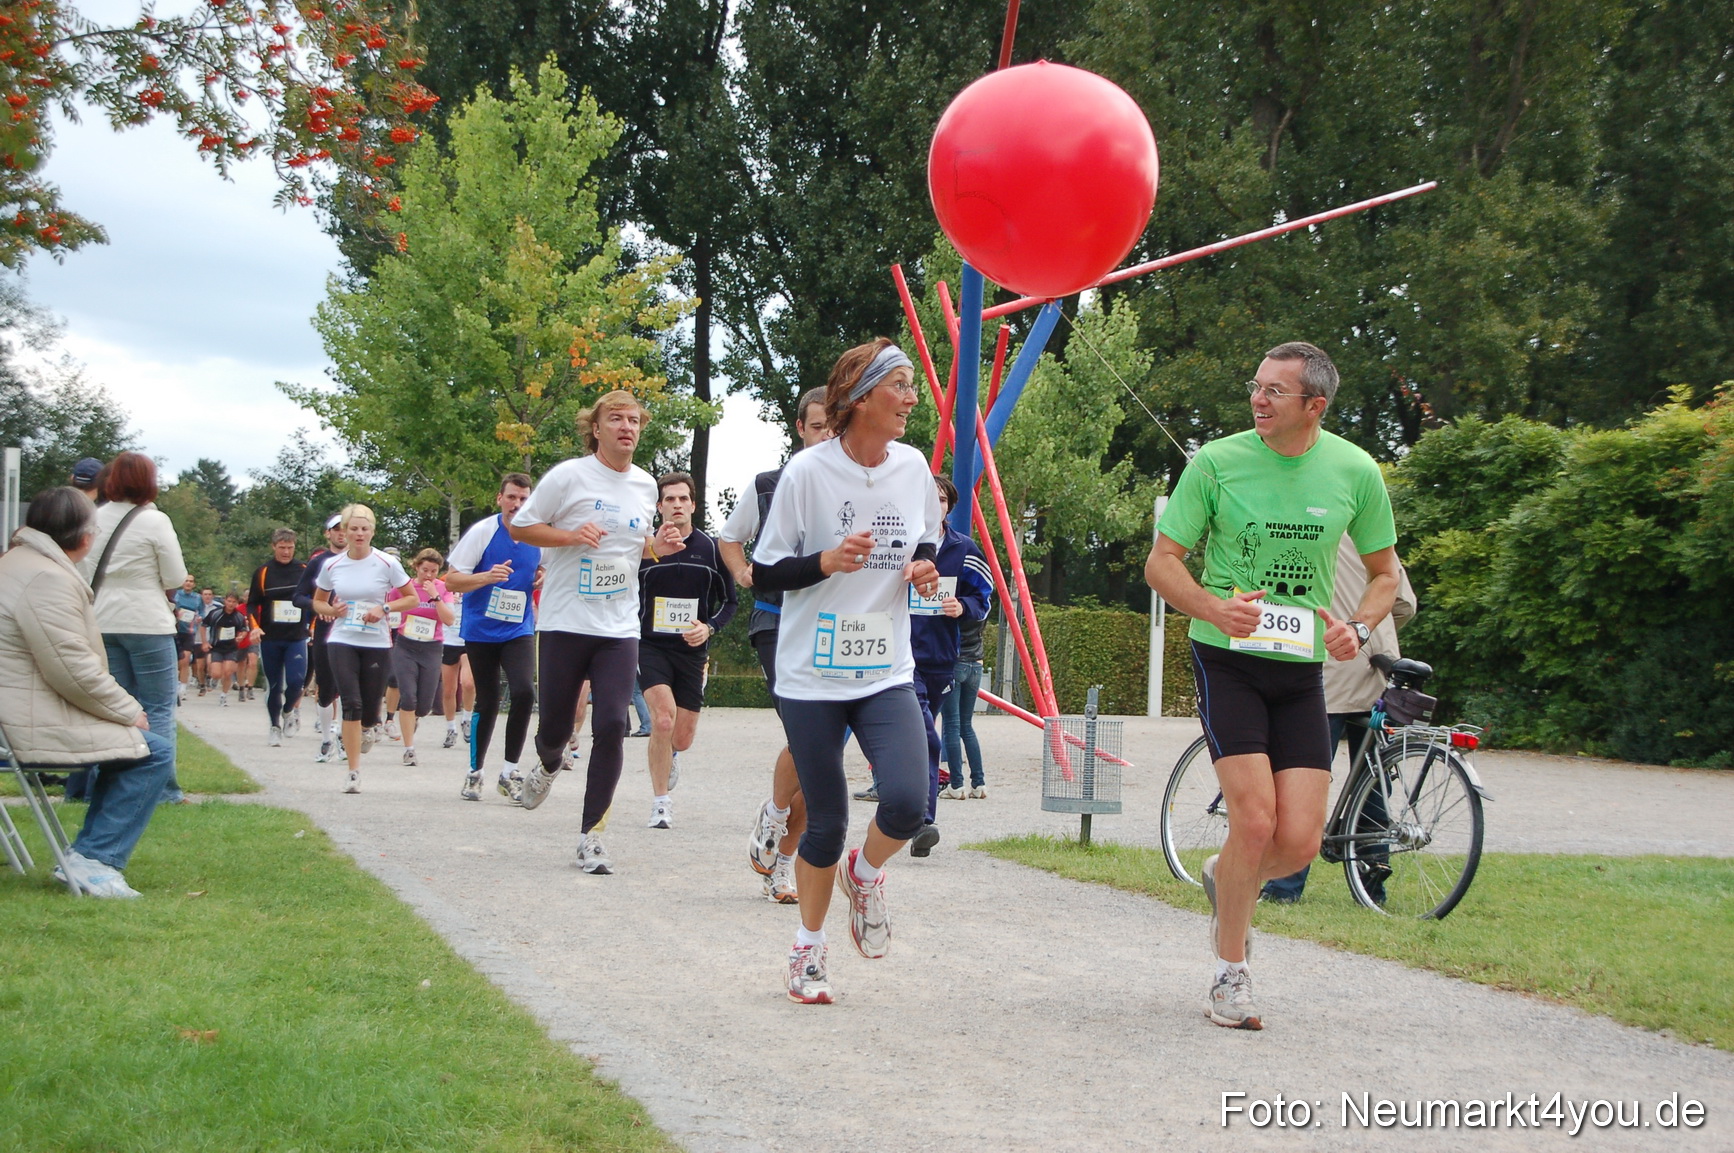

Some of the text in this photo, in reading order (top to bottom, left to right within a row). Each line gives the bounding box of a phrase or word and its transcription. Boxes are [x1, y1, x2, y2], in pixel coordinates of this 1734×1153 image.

[871, 528, 908, 536] 21.09.2008
[1265, 522, 1325, 533] NEUMARKTER
[1269, 531, 1320, 541] STADTLAUF
[869, 553, 906, 562] markter
[595, 564, 616, 572] Achim
[863, 561, 905, 571] Stadtlauf
[596, 573, 626, 587] 2290
[500, 601, 521, 612] 3396
[666, 601, 692, 609] Friedrich
[670, 612, 690, 622] 912
[841, 620, 866, 632] Erika
[1263, 612, 1301, 634] 369
[415, 625, 430, 634] 929
[841, 638, 887, 656] 3375
